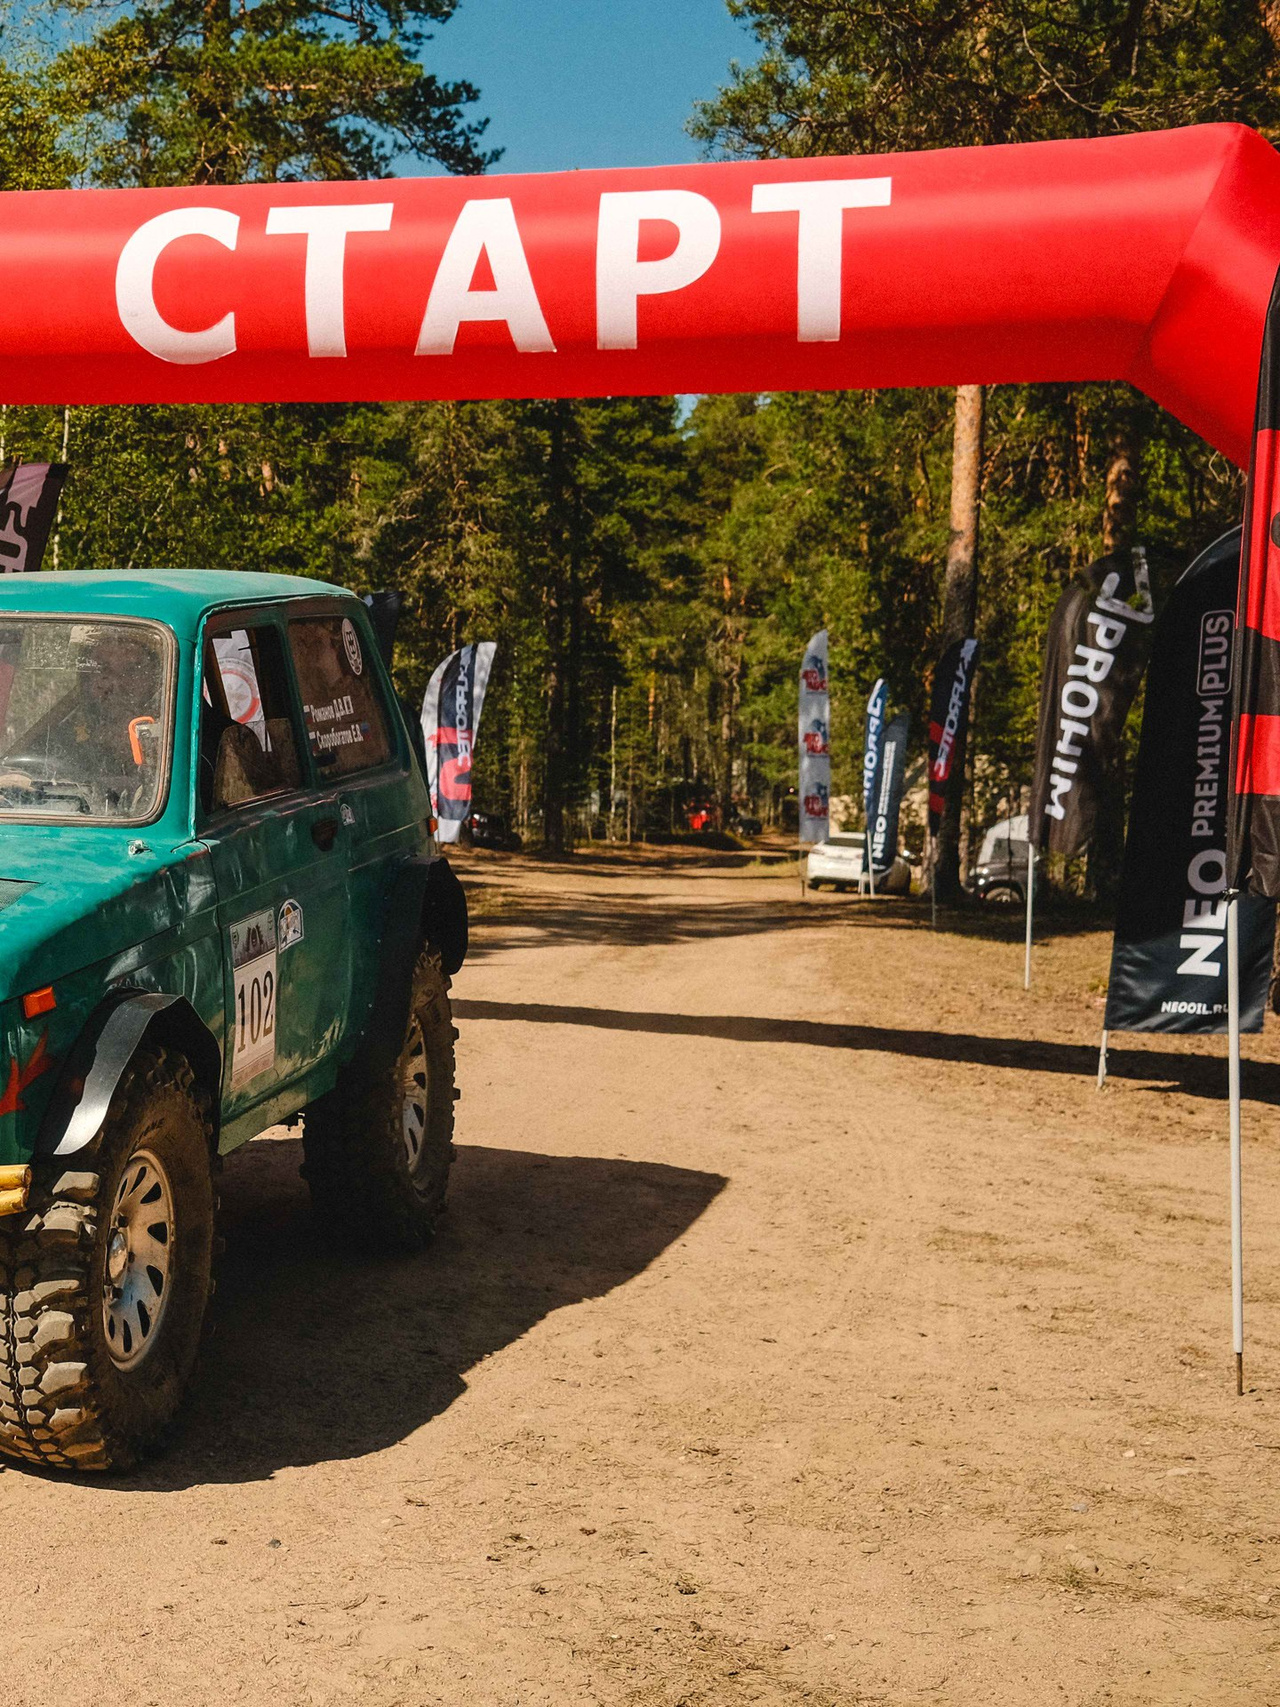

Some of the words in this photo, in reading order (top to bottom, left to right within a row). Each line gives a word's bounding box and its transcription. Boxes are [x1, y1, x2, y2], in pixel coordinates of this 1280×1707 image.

[115, 176, 893, 365] СТАРТ
[1201, 615, 1230, 690] PLUS
[1191, 699, 1224, 837] PREMIUM
[872, 815, 888, 859] NEO
[1176, 848, 1229, 977] NEO
[237, 970, 274, 1054] 102
